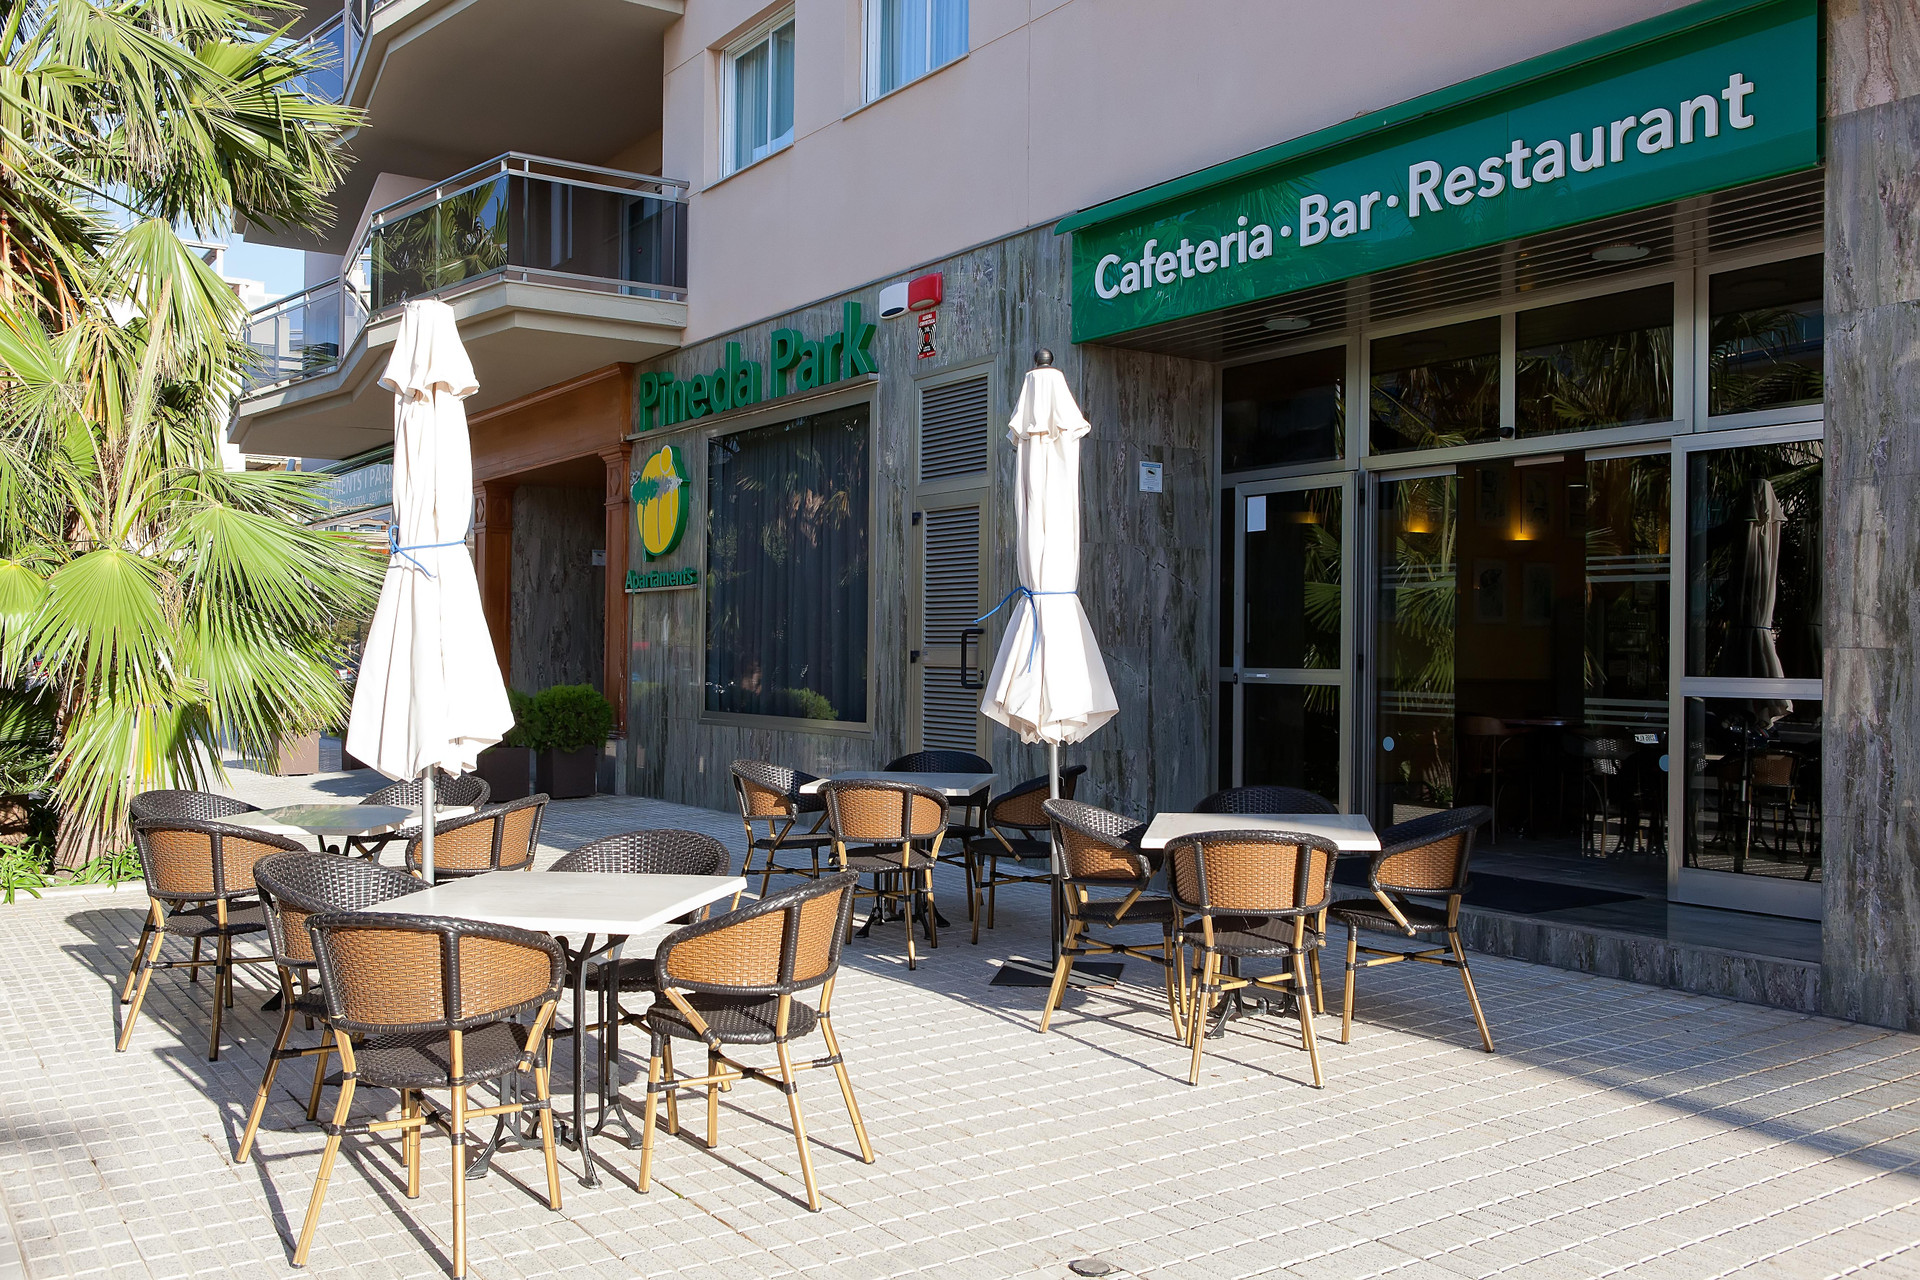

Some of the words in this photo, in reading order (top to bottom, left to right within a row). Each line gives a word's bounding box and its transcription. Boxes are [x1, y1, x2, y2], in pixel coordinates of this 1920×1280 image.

[1094, 216, 1273, 300] Cafeteria
[1299, 190, 1382, 247] Bar
[1408, 72, 1755, 218] Restaurant
[639, 341, 762, 432] Pineda
[770, 300, 879, 403] Park
[625, 567, 698, 594] Apartaments
